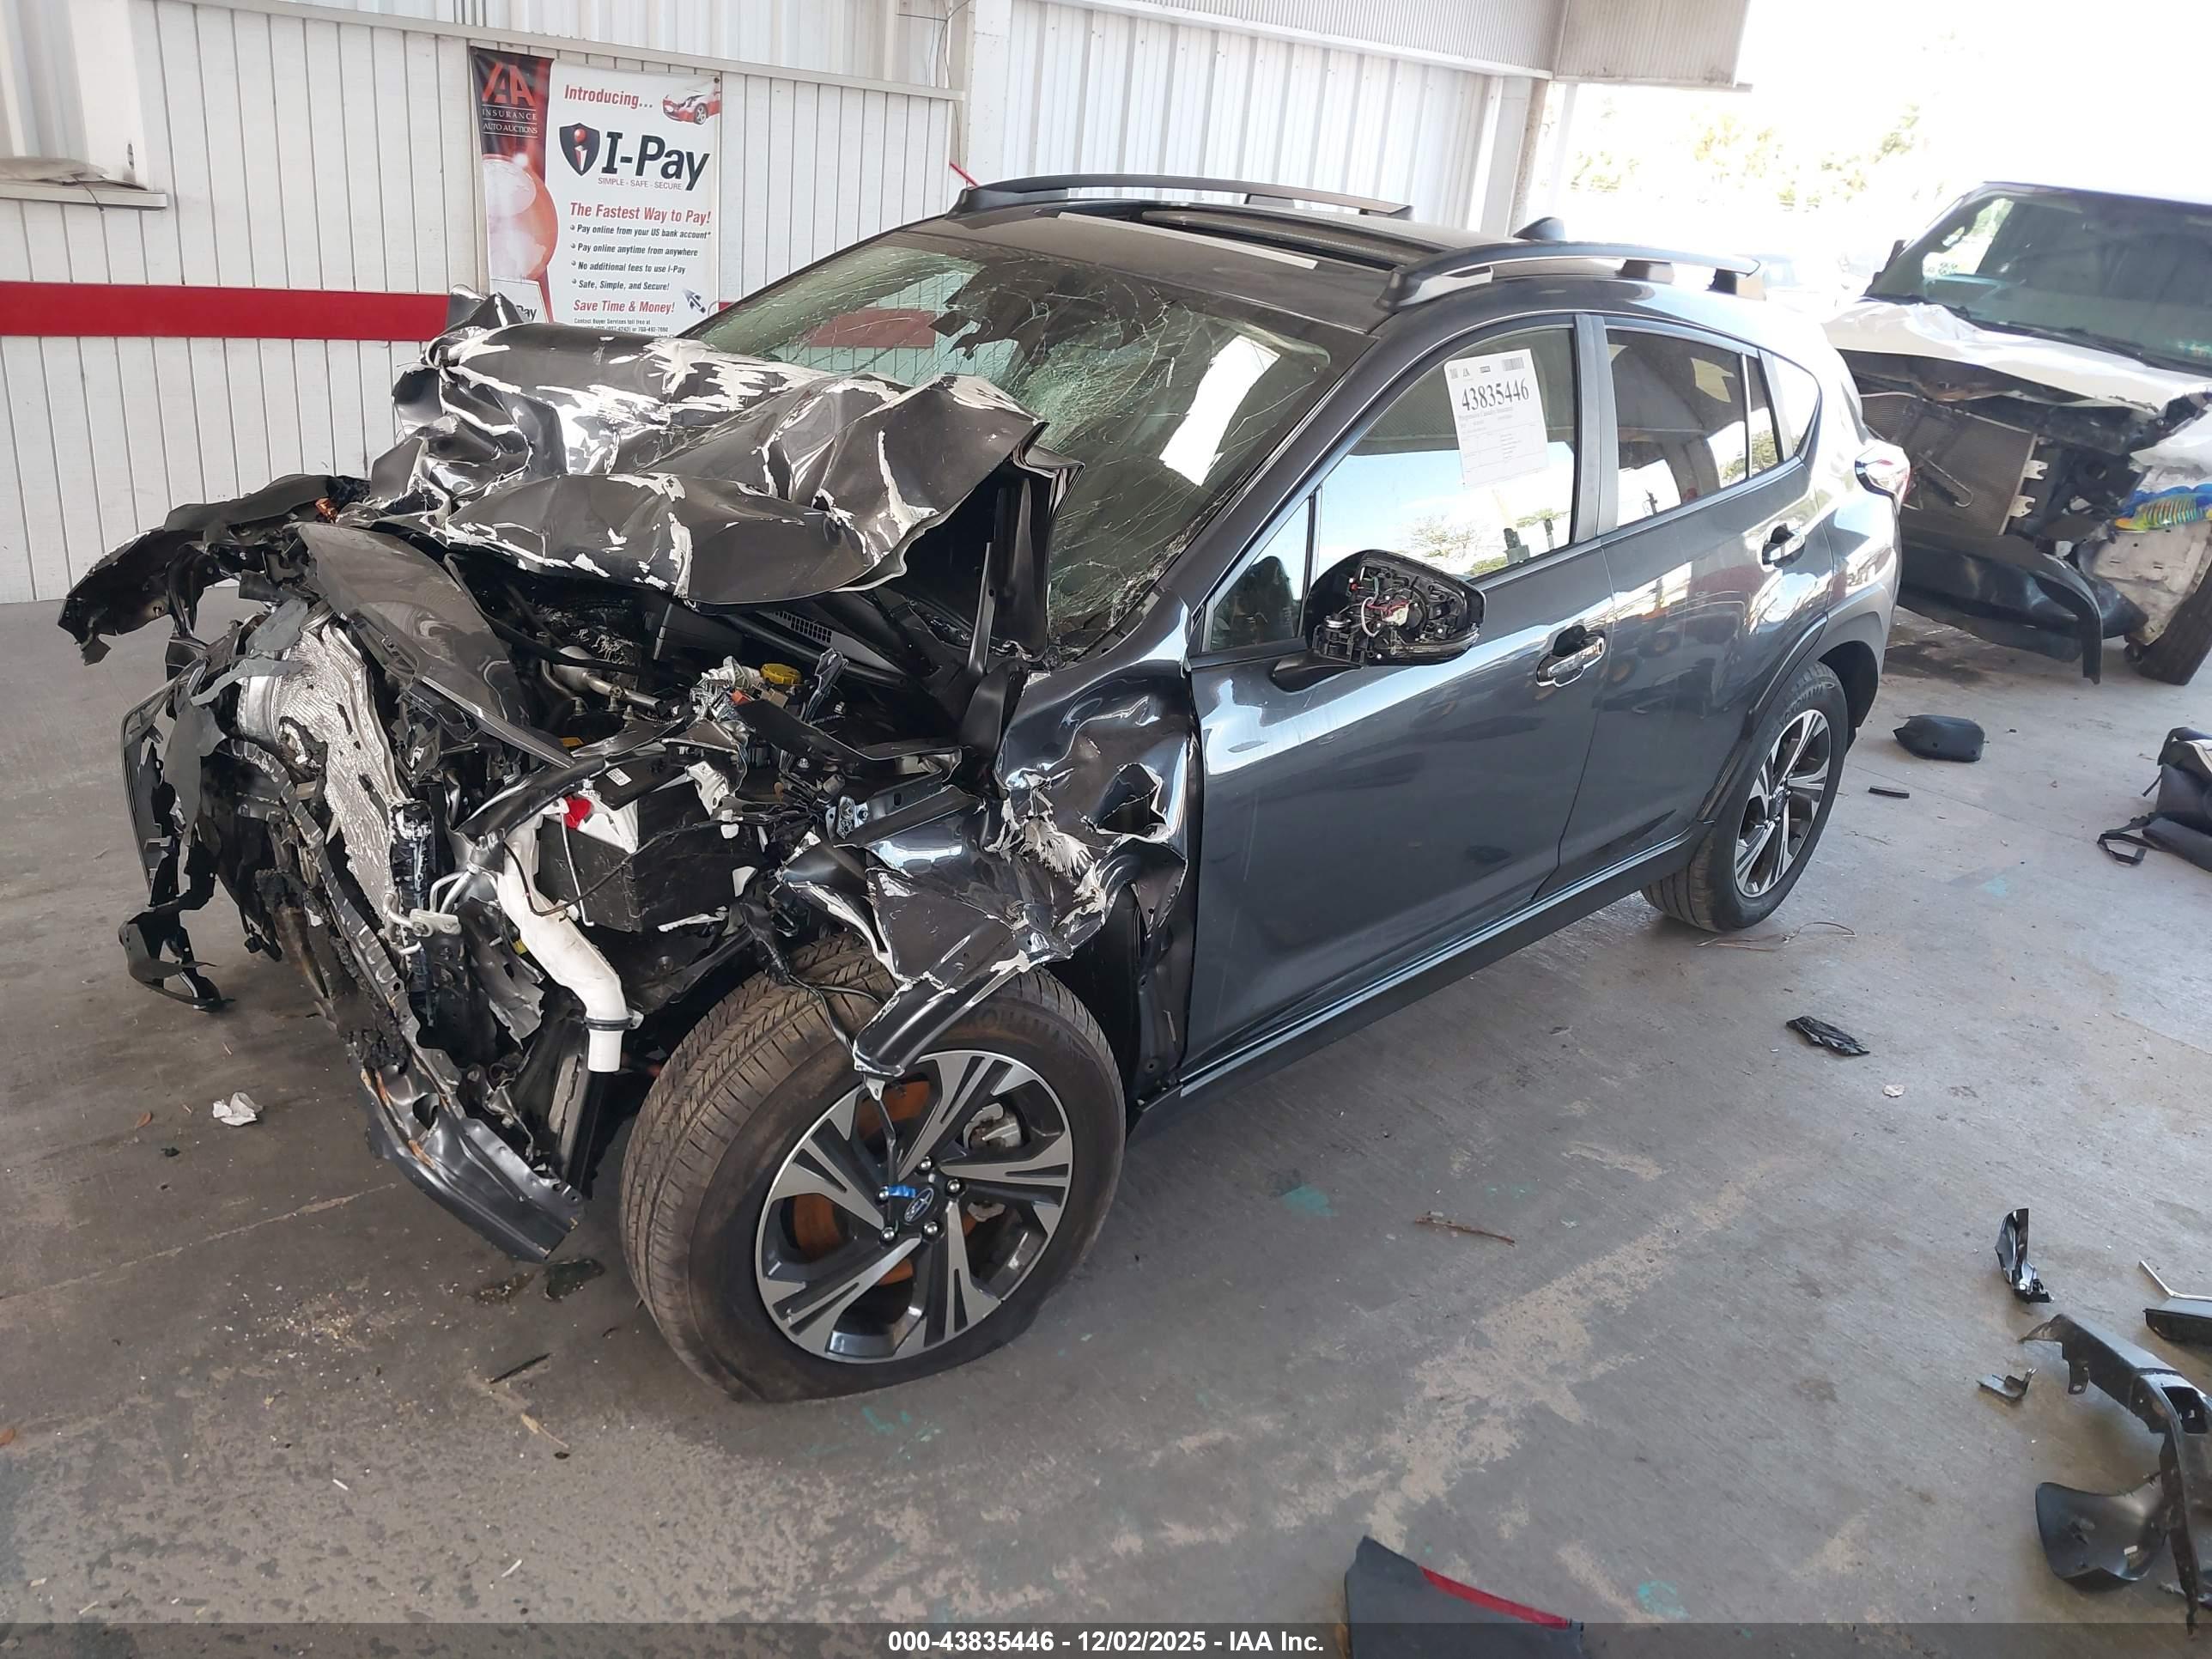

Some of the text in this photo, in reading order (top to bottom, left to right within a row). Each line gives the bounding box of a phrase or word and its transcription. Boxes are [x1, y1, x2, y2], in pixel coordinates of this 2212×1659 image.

[564, 84, 653, 110] Introducing...
[482, 108, 538, 121] INSURANCE
[483, 123, 538, 134] AUTO AUCTIONS
[600, 131, 710, 191] I-Pay
[598, 177, 625, 186] SIMPLE
[630, 179, 649, 188] SAFE
[654, 181, 683, 191] SECURE
[570, 202, 712, 227] The Fastest Way to Pay!
[576, 224, 591, 234] Pay
[592, 225, 615, 235] online
[616, 227, 633, 235] from
[634, 228, 649, 237] your
[651, 228, 660, 237] US
[661, 228, 678, 238] bank
[577, 242, 699, 257] Pay online anytime from anywhere
[578, 261, 588, 270] No
[589, 262, 627, 272] additional
[627, 263, 644, 273] fees
[645, 264, 653, 273] to
[667, 264, 687, 275] I-Pay
[578, 280, 670, 291] Safe, Simple, and Secure!
[574, 299, 676, 315] Save Time & Money!
[1462, 378, 1529, 411] 43835446
